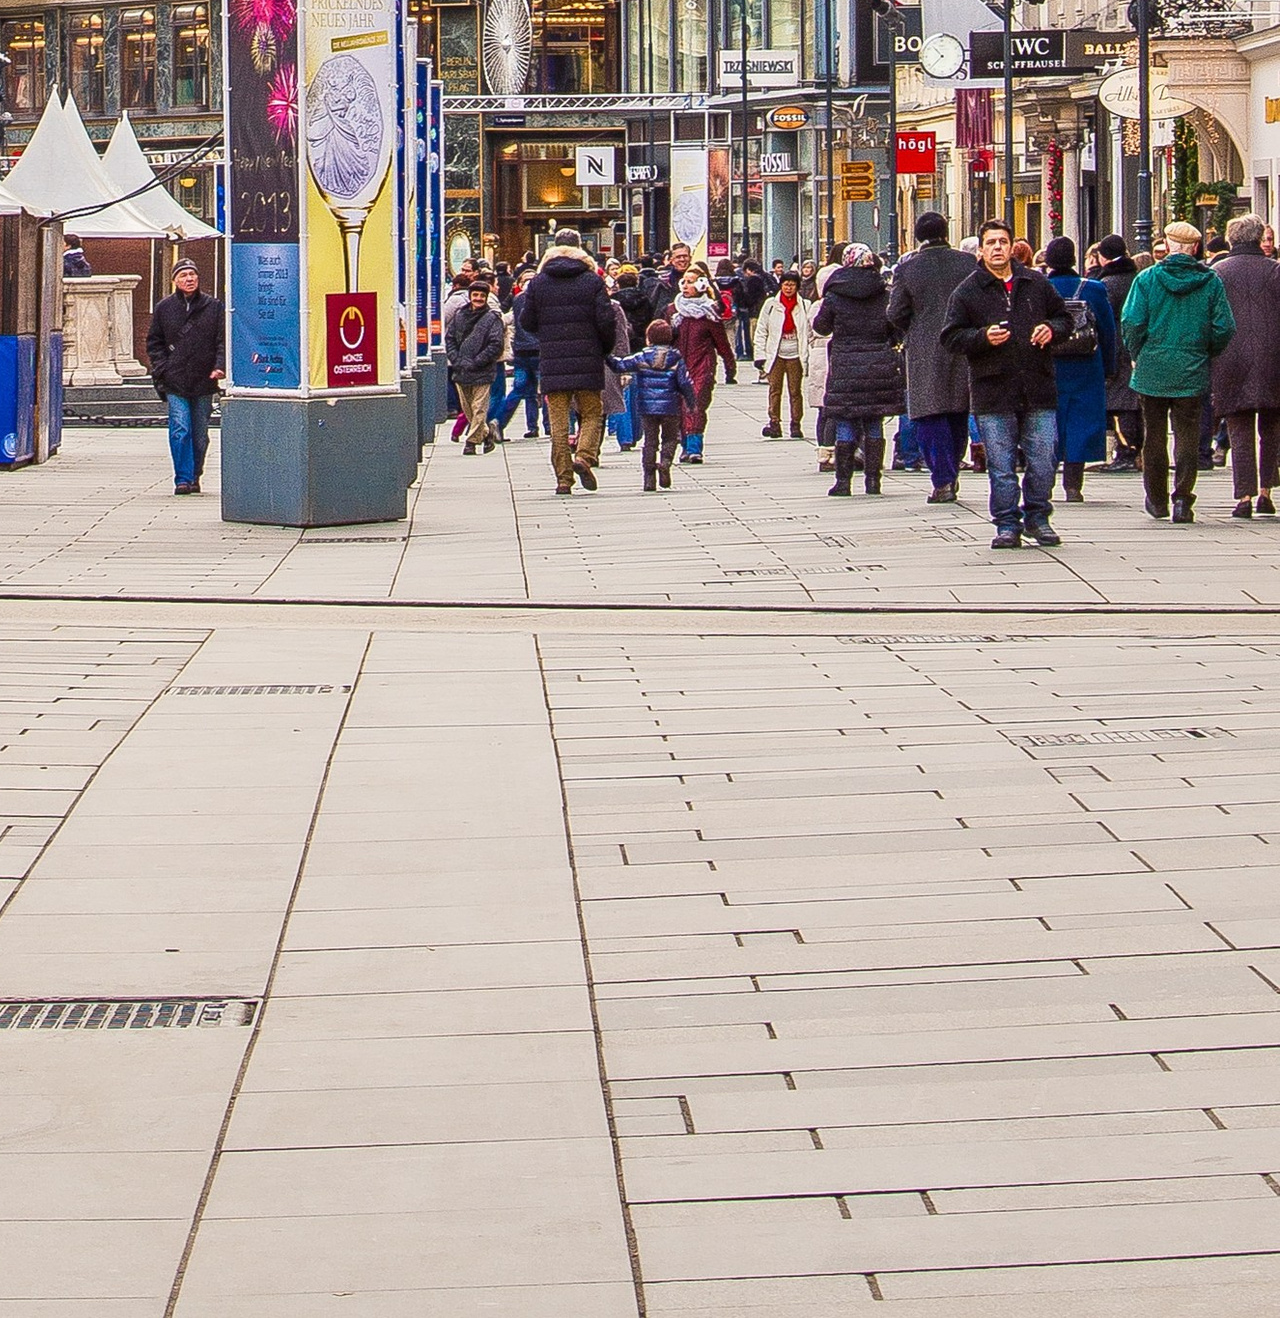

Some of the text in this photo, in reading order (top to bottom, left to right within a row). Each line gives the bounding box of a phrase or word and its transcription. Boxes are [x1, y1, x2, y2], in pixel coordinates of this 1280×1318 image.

[311, 13, 375, 30] NEUES JAHR
[1009, 38, 1050, 55] IWC
[773, 113, 807, 123] FOSSIL
[760, 153, 791, 172] FOSSIL
[240, 192, 291, 233] 2013
[342, 352, 364, 363] MÜNZE
